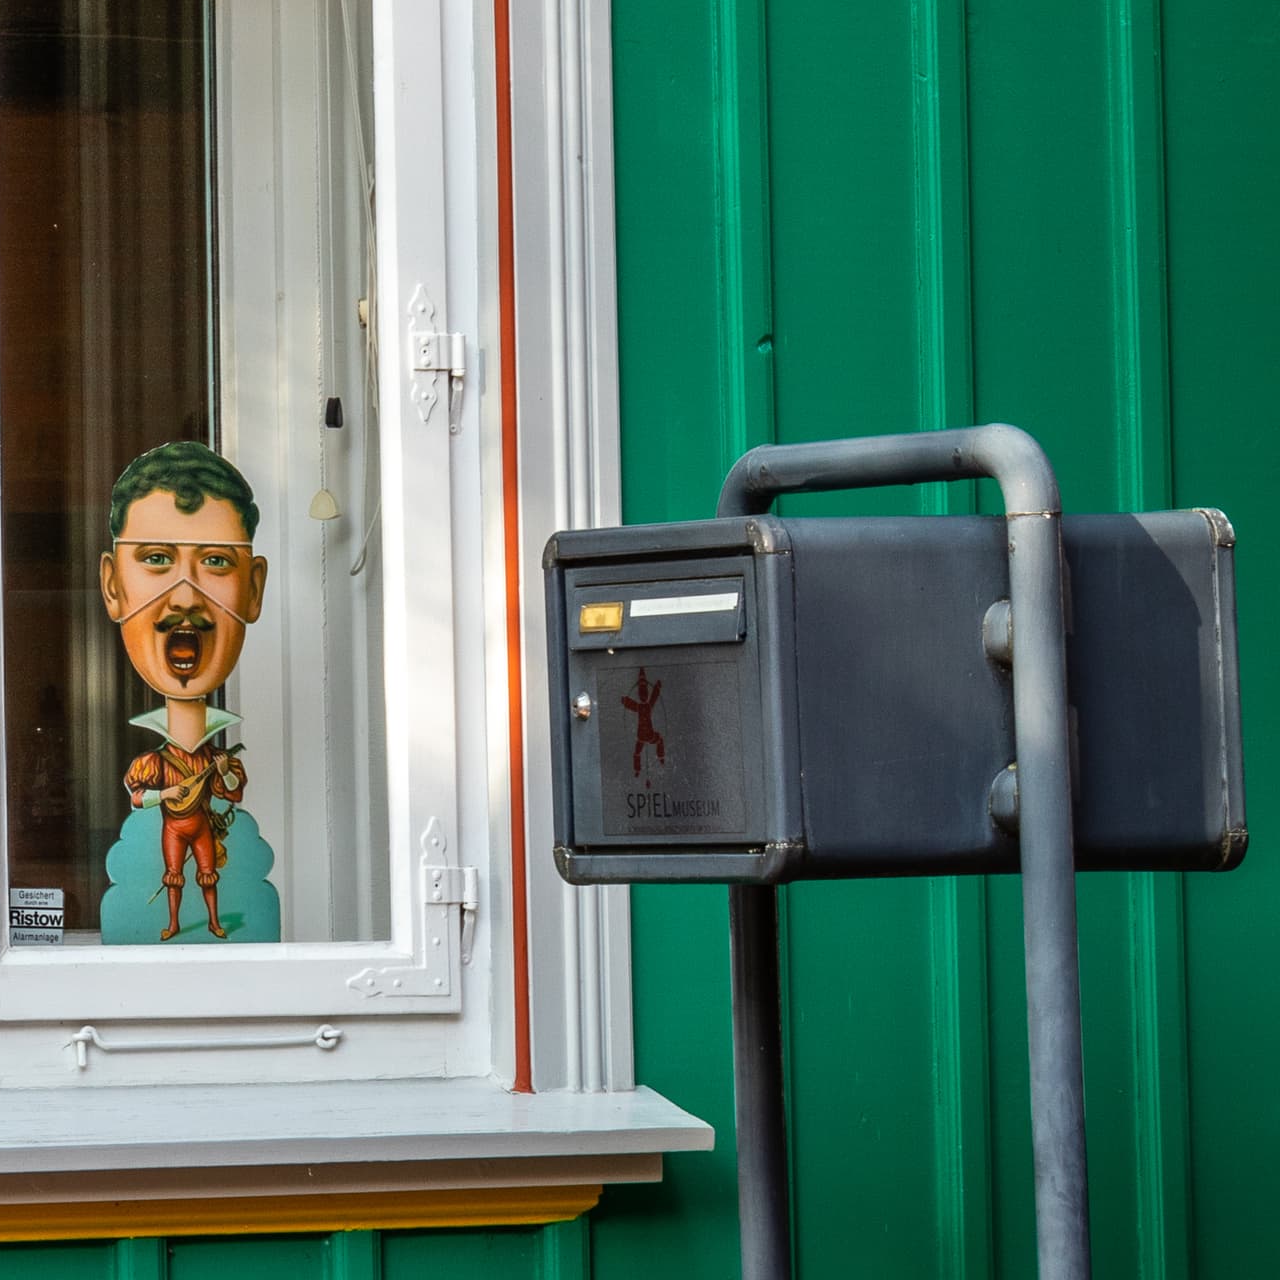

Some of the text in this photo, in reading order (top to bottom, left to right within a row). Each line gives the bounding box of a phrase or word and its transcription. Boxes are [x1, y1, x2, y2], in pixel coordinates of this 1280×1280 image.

[18, 890, 55, 900] Gesichert
[9, 910, 63, 926] Ristow
[13, 932, 59, 943] Alarmanlage
